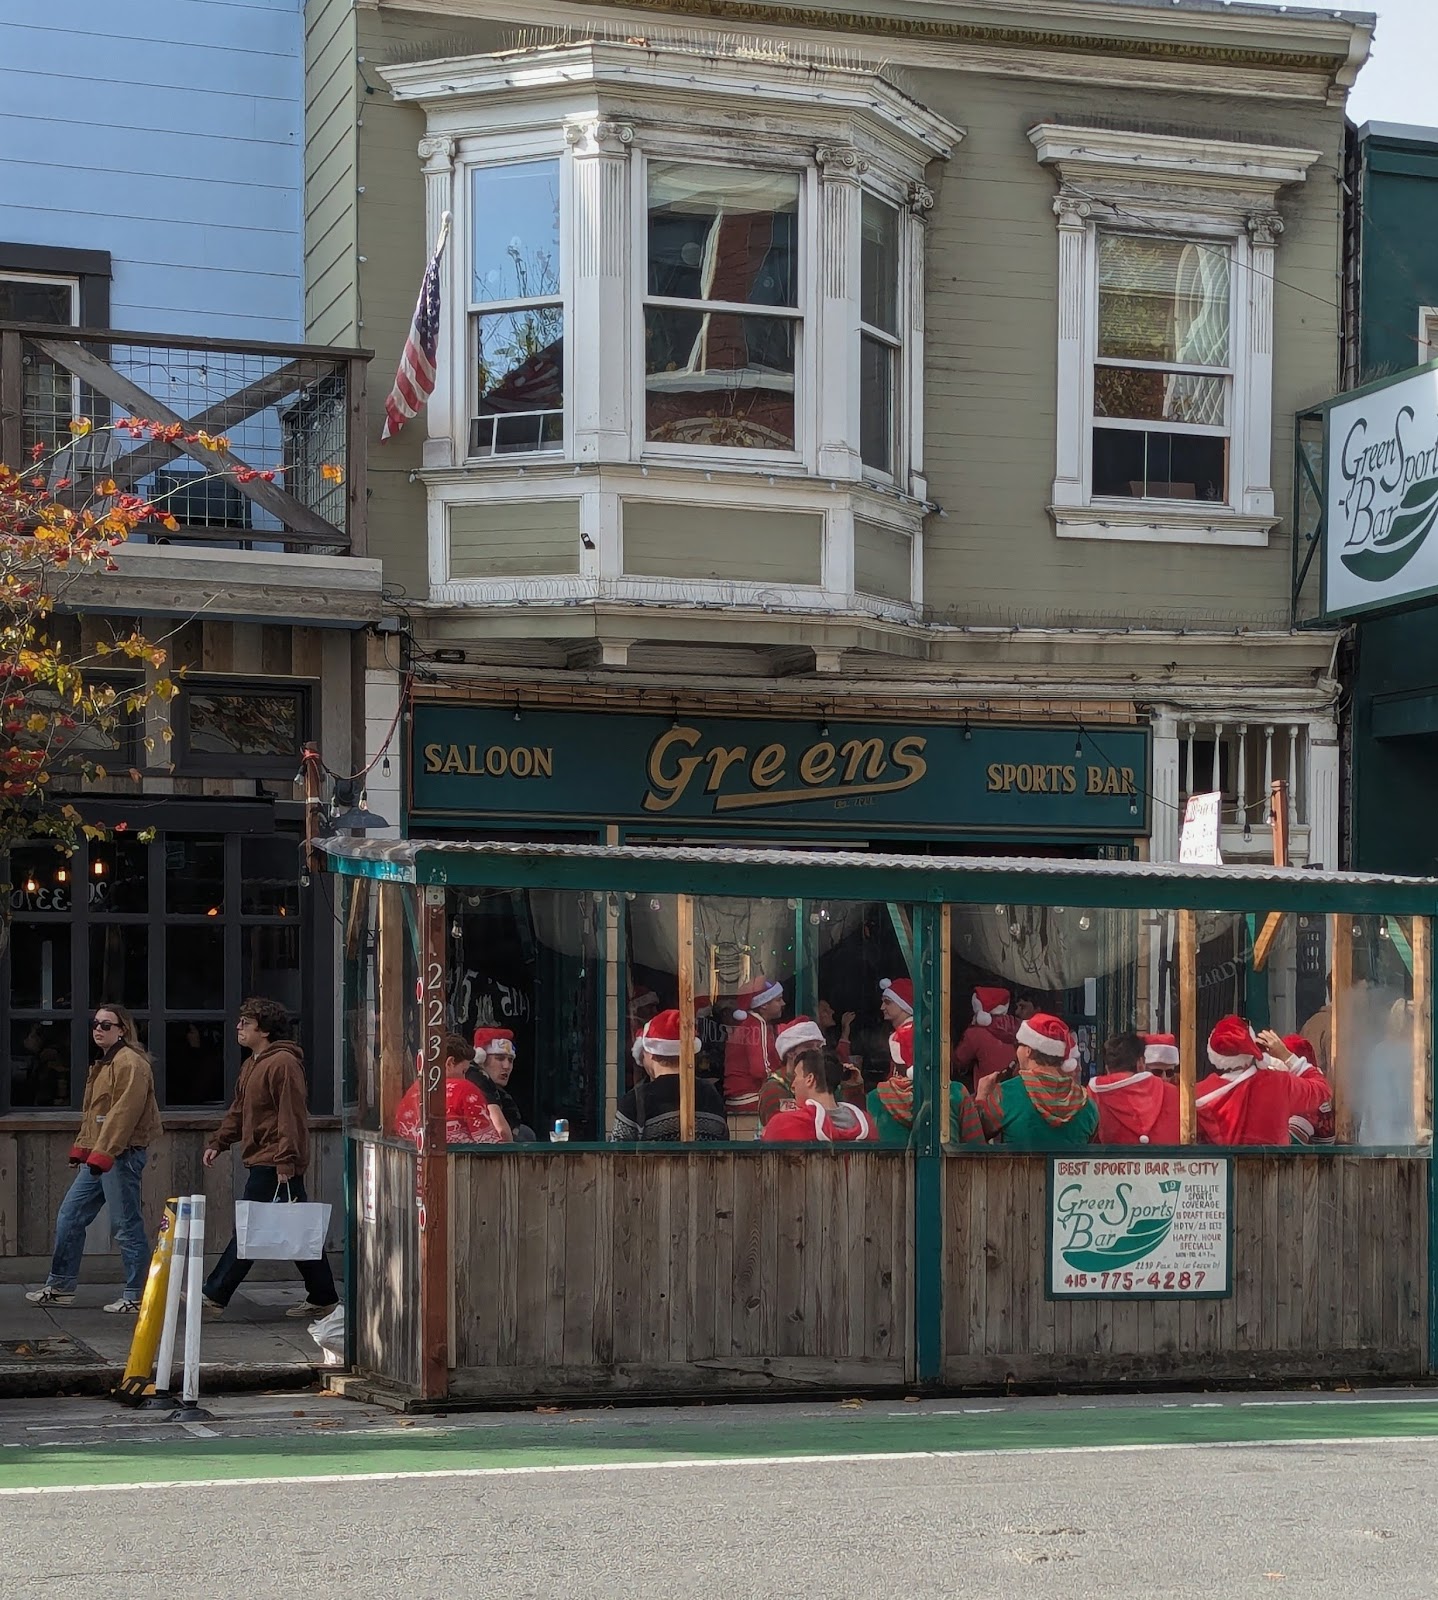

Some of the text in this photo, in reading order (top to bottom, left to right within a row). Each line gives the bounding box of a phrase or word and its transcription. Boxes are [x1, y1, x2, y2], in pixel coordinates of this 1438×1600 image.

[1341, 417, 1396, 499] Green
[1343, 476, 1398, 548] Bar
[424, 743, 553, 777] SALOON
[643, 726, 927, 812] Greens
[987, 763, 1137, 795] SPORTS BAR
[427, 962, 443, 1092] 2239
[1058, 1161, 1090, 1176] BEST
[1093, 1161, 1141, 1176] SPORTS
[1144, 1161, 1170, 1176] BAR
[1187, 1161, 1219, 1176] CITY
[1184, 1184, 1220, 1193] SATELLITE
[1188, 1191, 1213, 1201] SPORTS
[1057, 1183, 1174, 1231] Green Sports
[1061, 1213, 1116, 1251] Bar
[1172, 1233, 1222, 1241] HAPPY HOUR
[1180, 1242, 1214, 1250] SPECIALS
